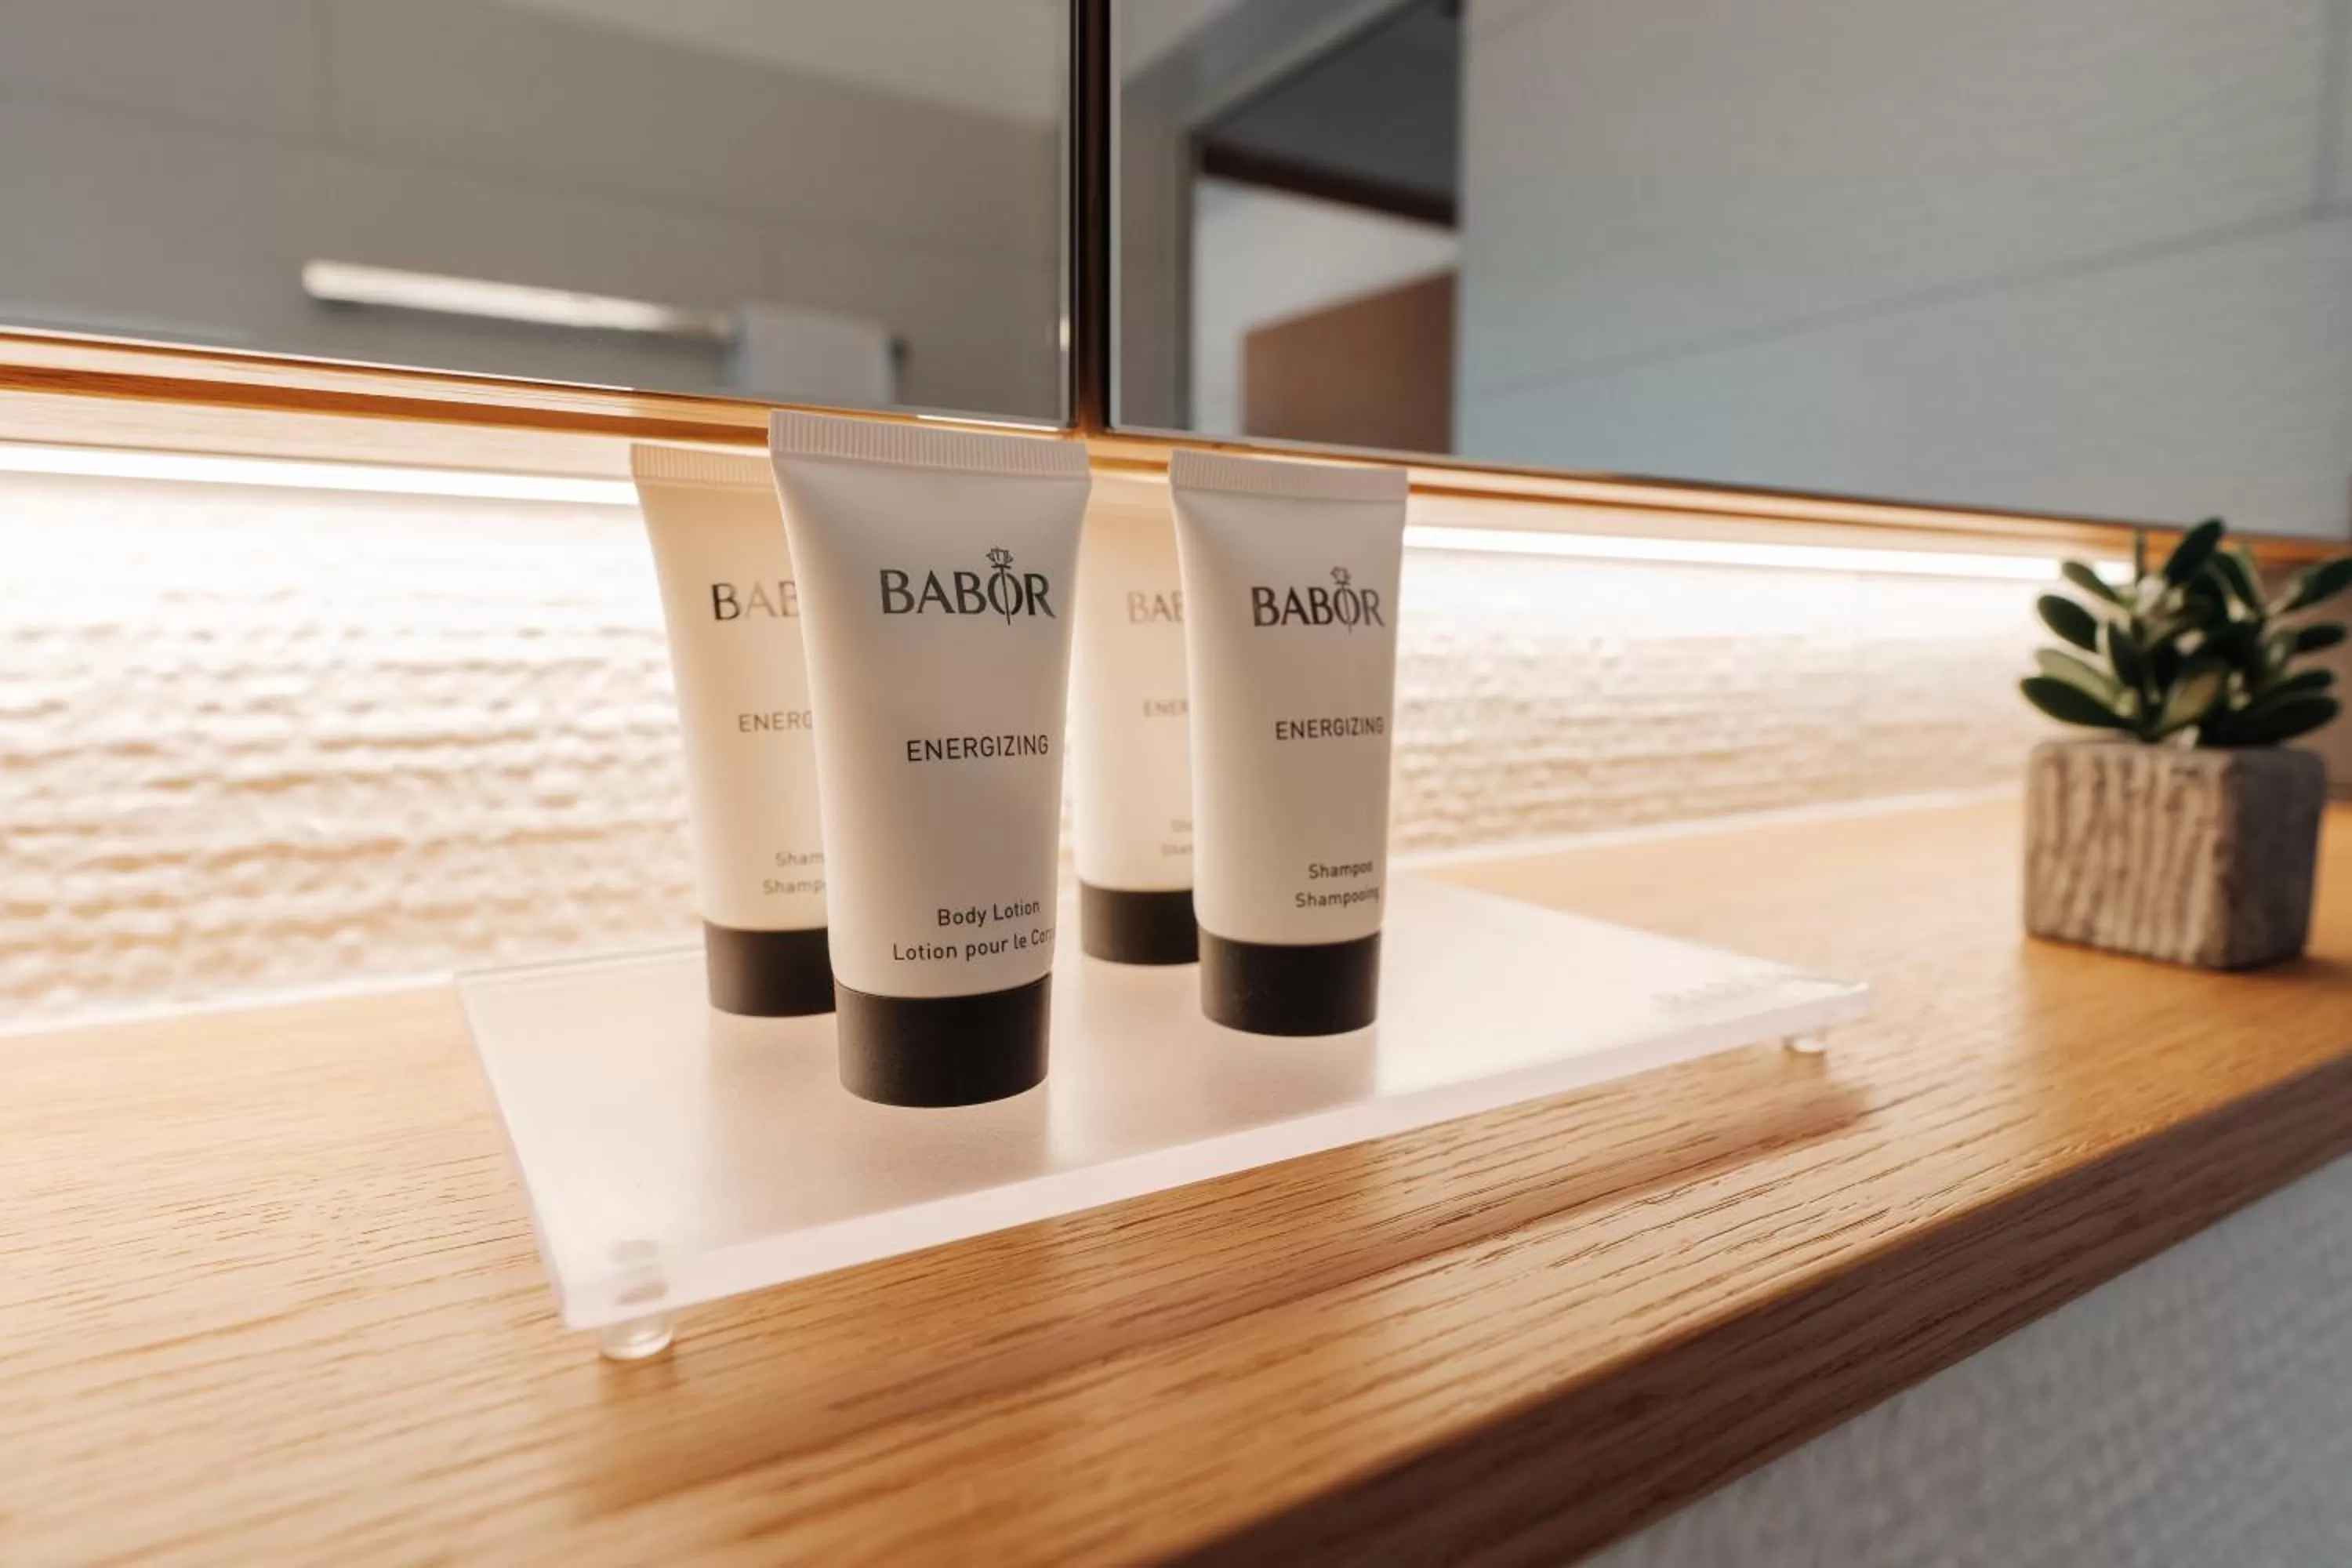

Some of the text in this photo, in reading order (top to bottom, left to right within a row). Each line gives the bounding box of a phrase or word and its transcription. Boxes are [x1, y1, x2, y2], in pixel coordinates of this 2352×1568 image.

[880, 568, 1057, 626] BABOR
[1250, 585, 1385, 632] BABOR
[1275, 716, 1385, 740] ENERGIZING
[907, 735, 1050, 762] ENERGIZING
[937, 899, 1040, 927] Body Lotion
[893, 942, 957, 961] Lotion
[965, 938, 1008, 961] pour
[1014, 933, 1027, 949] le
